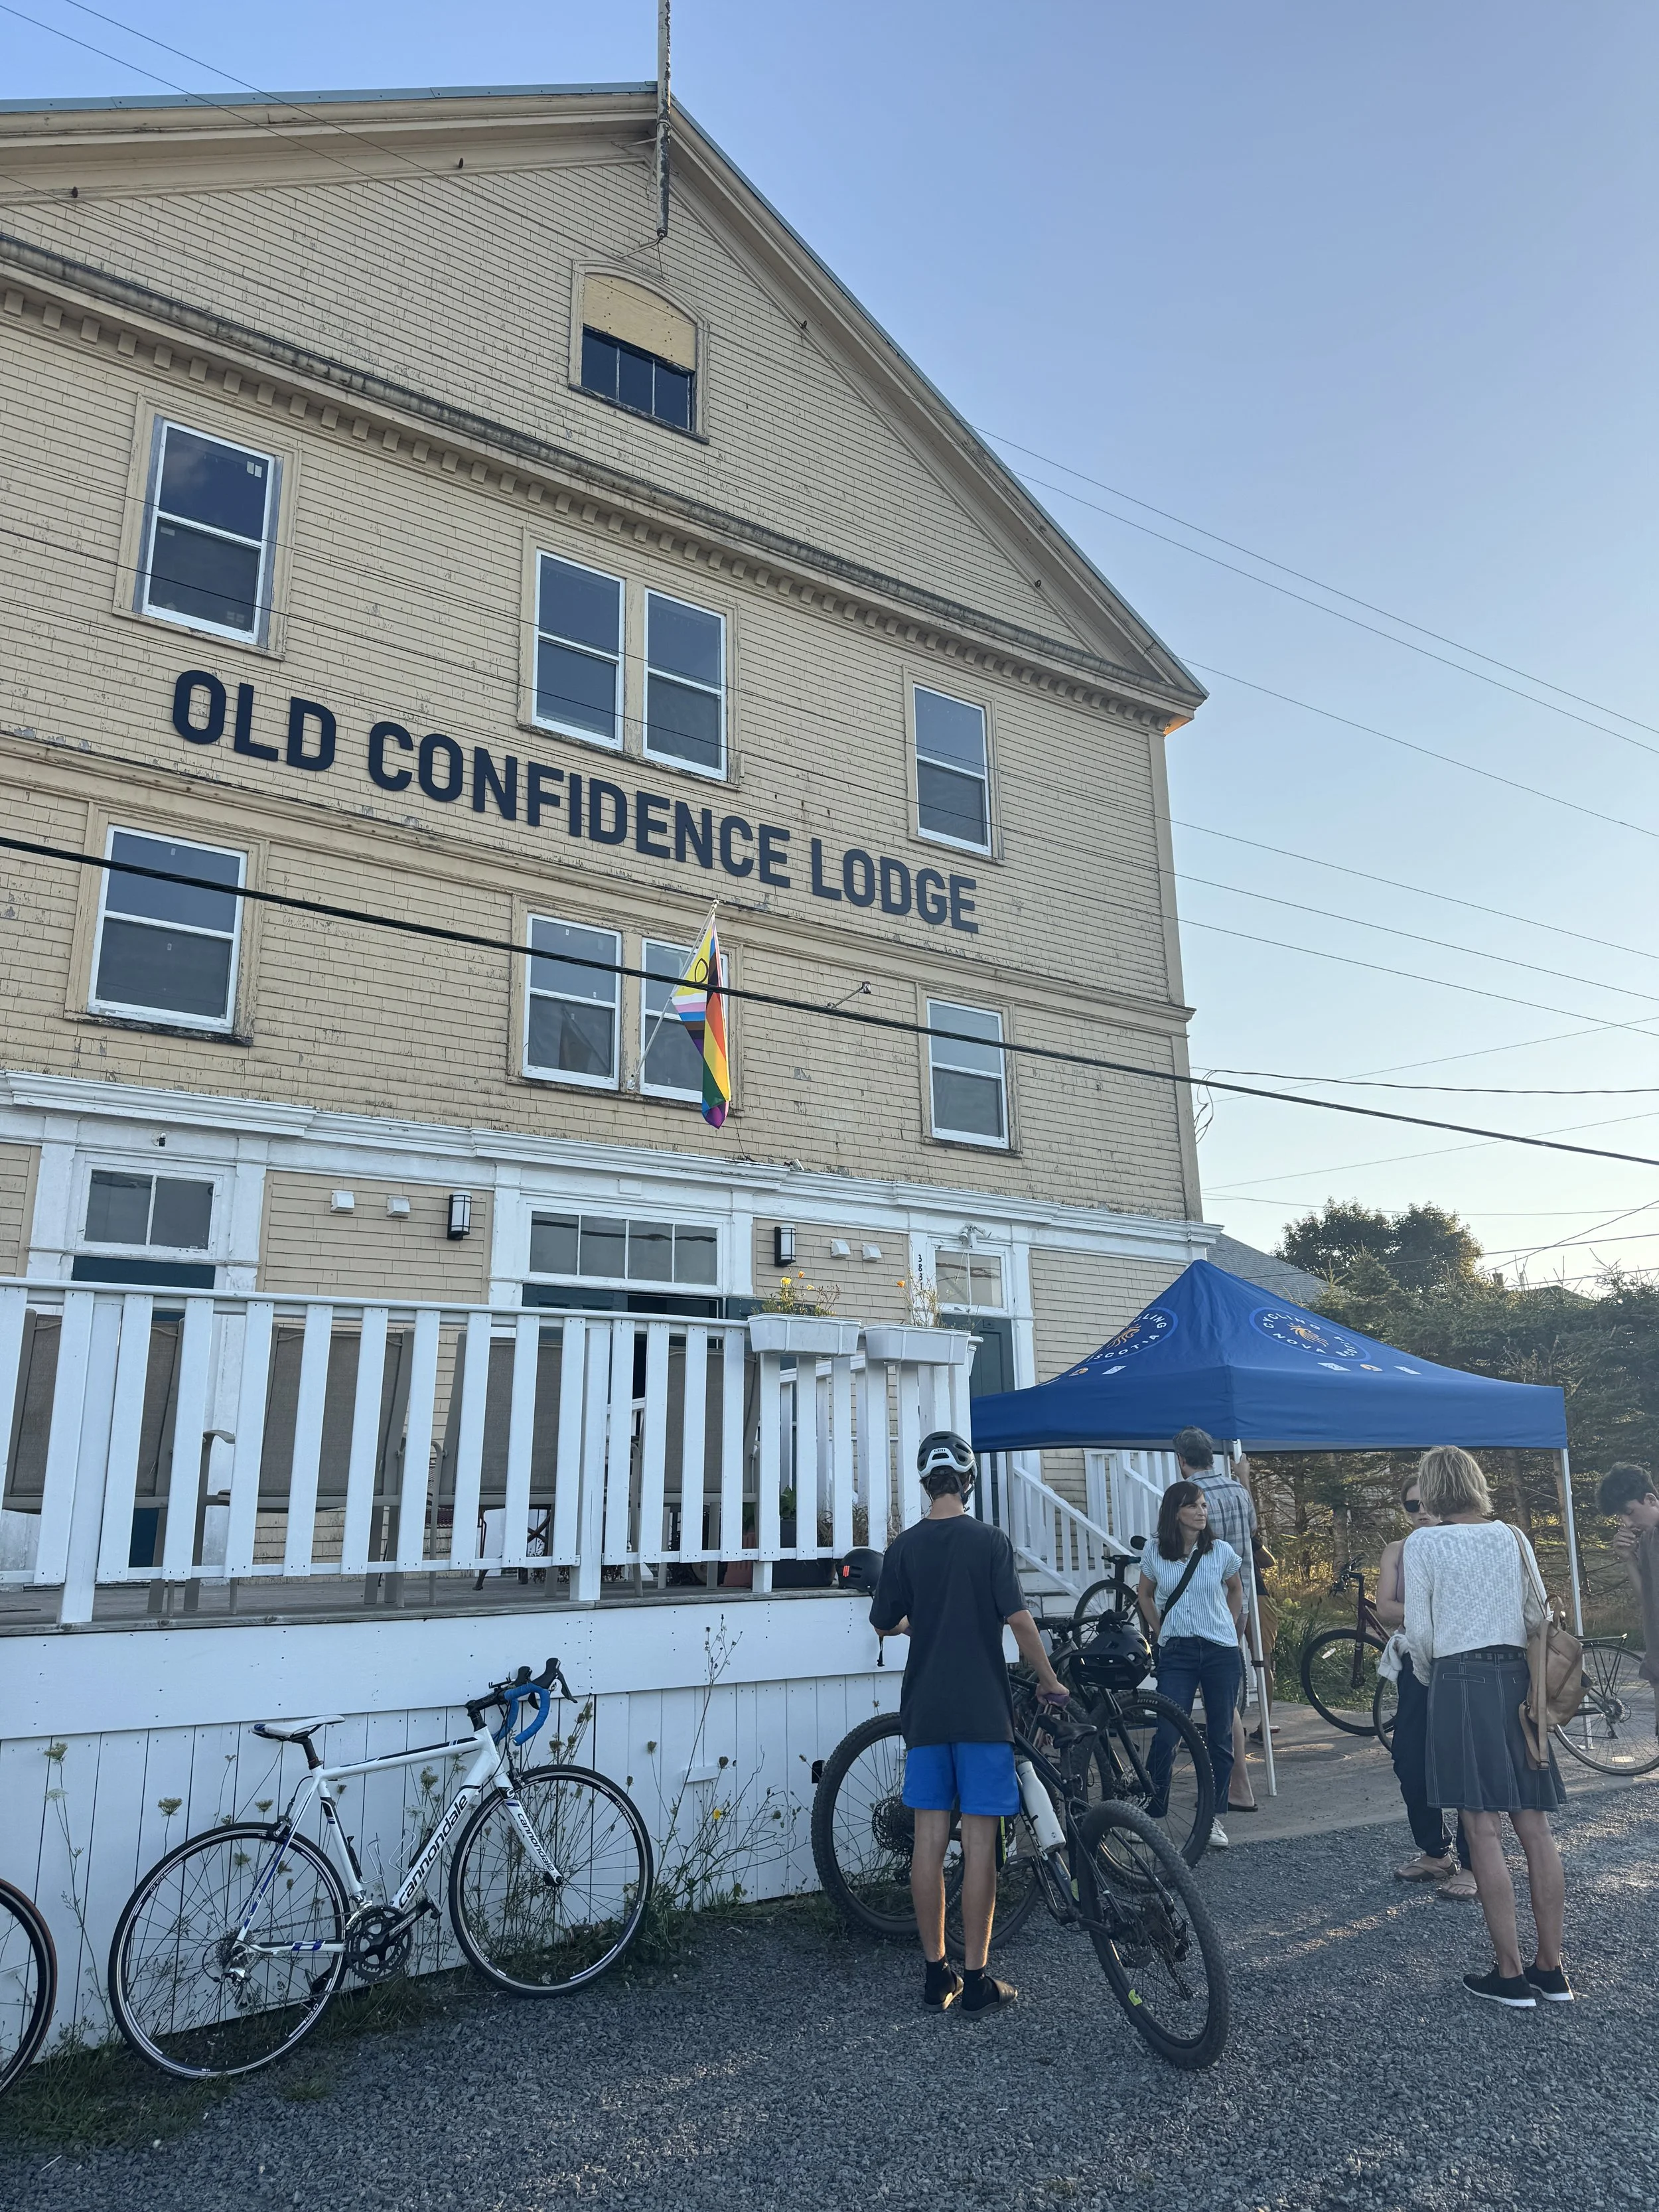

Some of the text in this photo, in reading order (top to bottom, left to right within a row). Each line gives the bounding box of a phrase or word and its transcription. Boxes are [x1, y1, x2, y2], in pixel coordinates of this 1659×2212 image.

[173, 670, 978, 932] OLD CONFIDENCE LODGE
[1263, 1313, 1321, 1330] CYCLING
[1094, 1335, 1160, 1359] SCOTIA
[1273, 1333, 1327, 1354] NOVA
[399, 1795, 468, 1909] cannondale
[518, 1813, 554, 1872] cannondale
